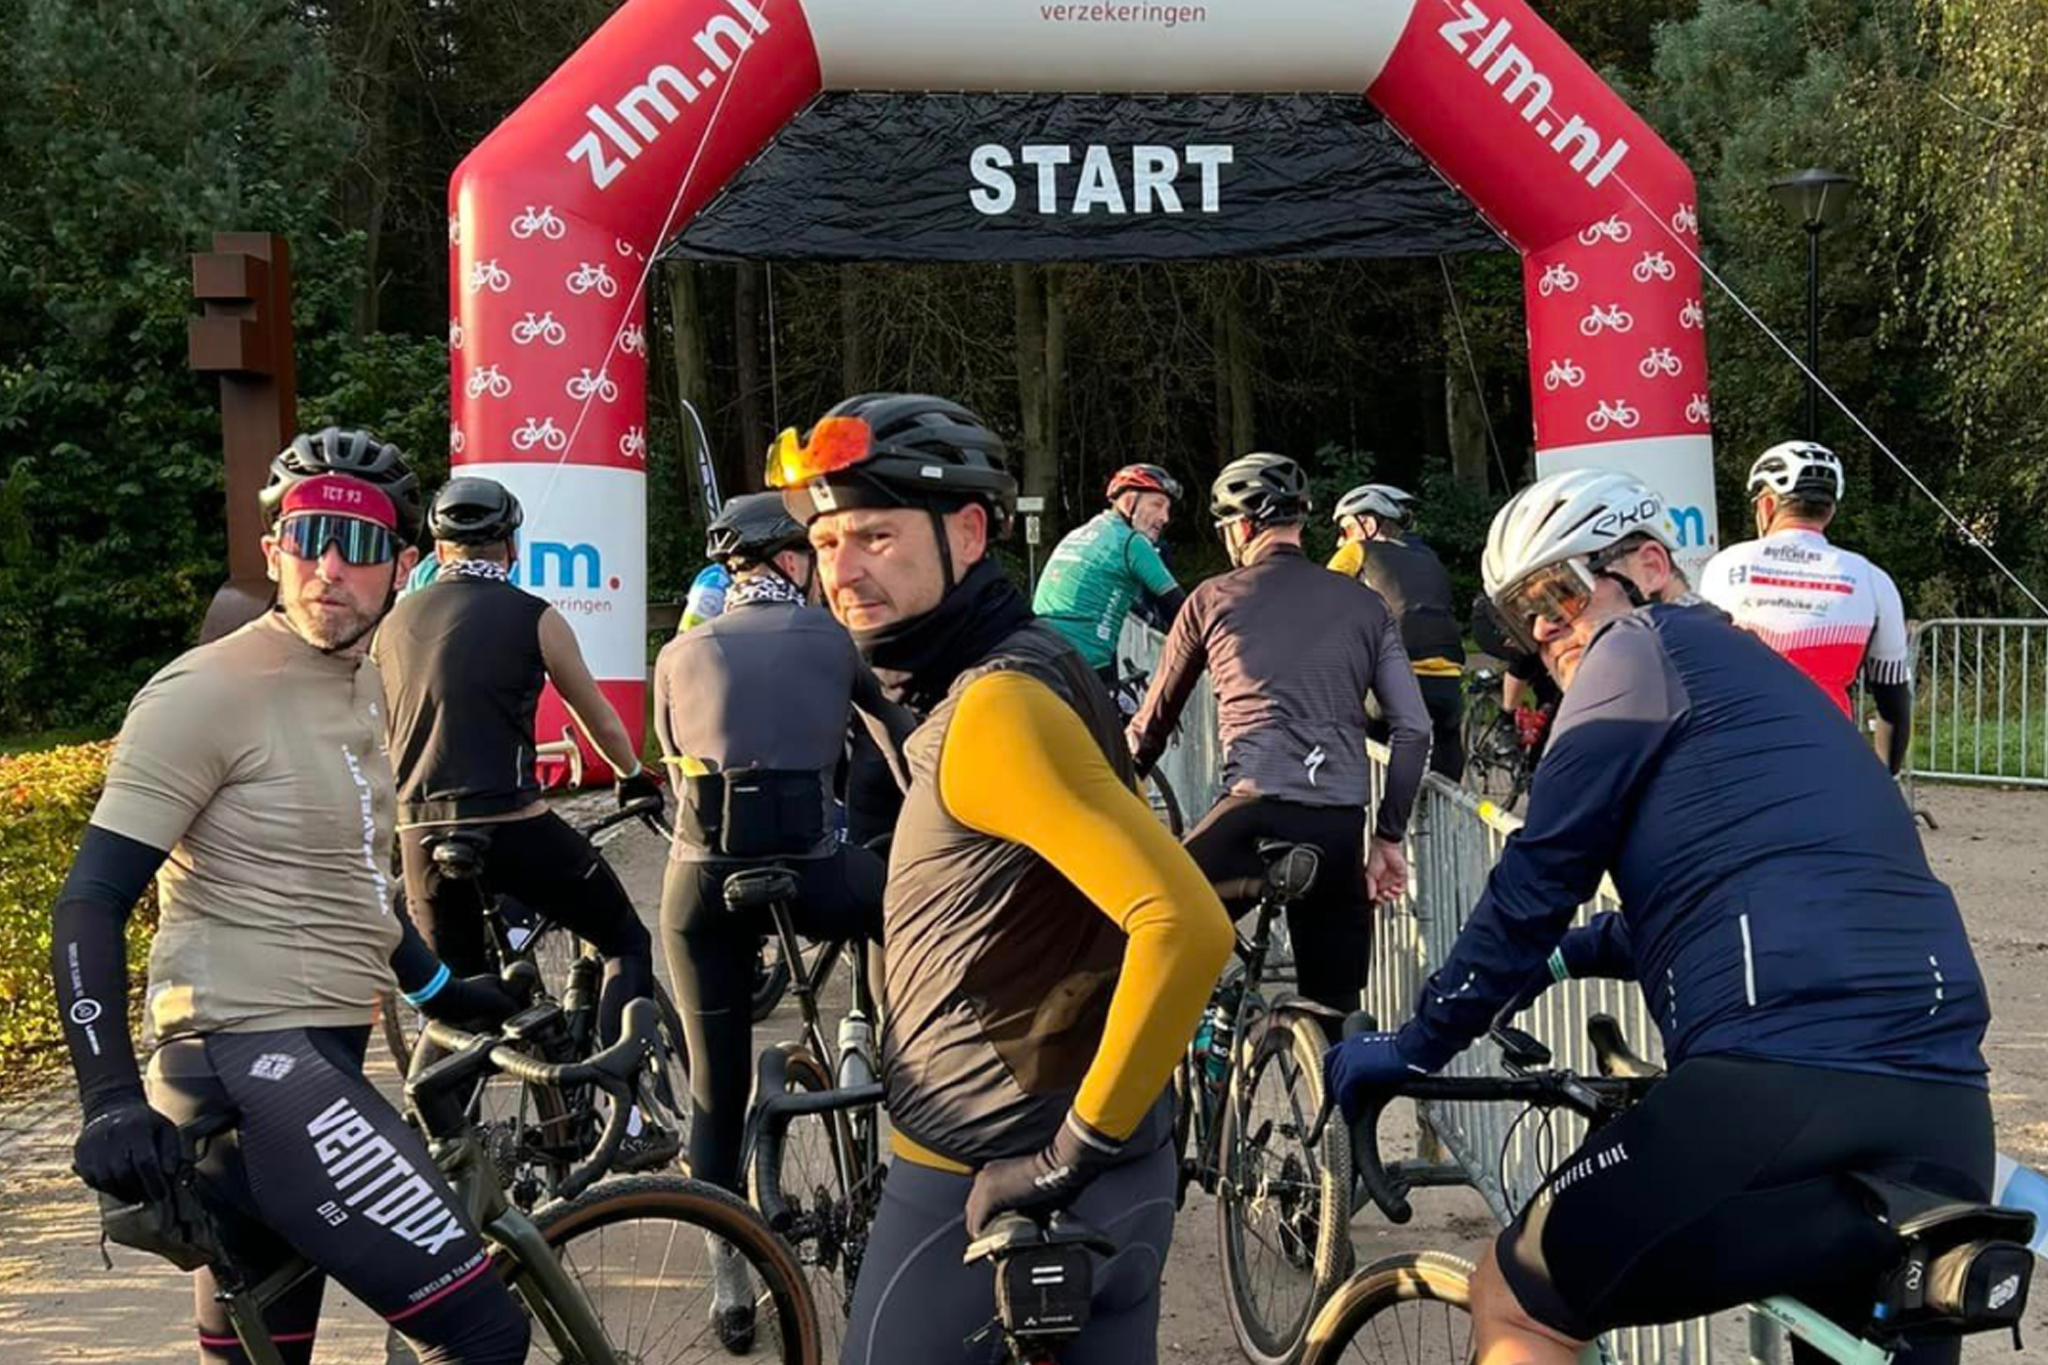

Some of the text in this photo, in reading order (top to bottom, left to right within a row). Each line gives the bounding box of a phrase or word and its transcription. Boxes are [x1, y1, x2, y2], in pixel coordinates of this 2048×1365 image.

[1040, 1, 1206, 27] verzekeringen
[565, 0, 771, 190] zlm.nl
[1438, 0, 1630, 188] zlm.nl
[968, 143, 1234, 215] START
